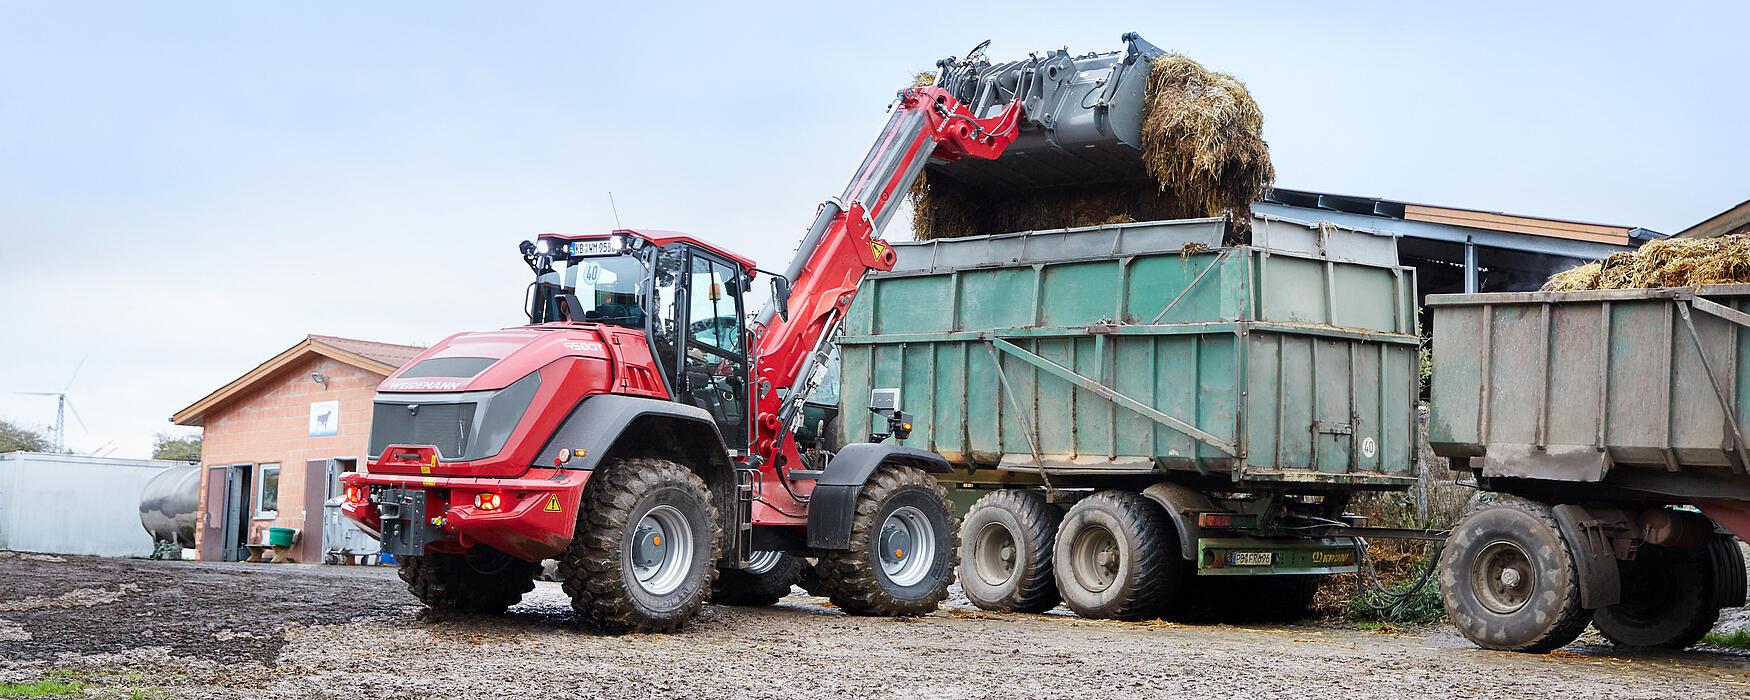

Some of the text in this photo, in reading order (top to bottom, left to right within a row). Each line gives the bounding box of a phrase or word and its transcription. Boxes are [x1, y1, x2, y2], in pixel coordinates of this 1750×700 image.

[937, 100, 960, 132] WEIDEANN
[586, 265, 597, 280] 40
[564, 342, 602, 351] 9580T
[389, 381, 460, 390] WEIDEMANN
[1364, 440, 1374, 453] 40
